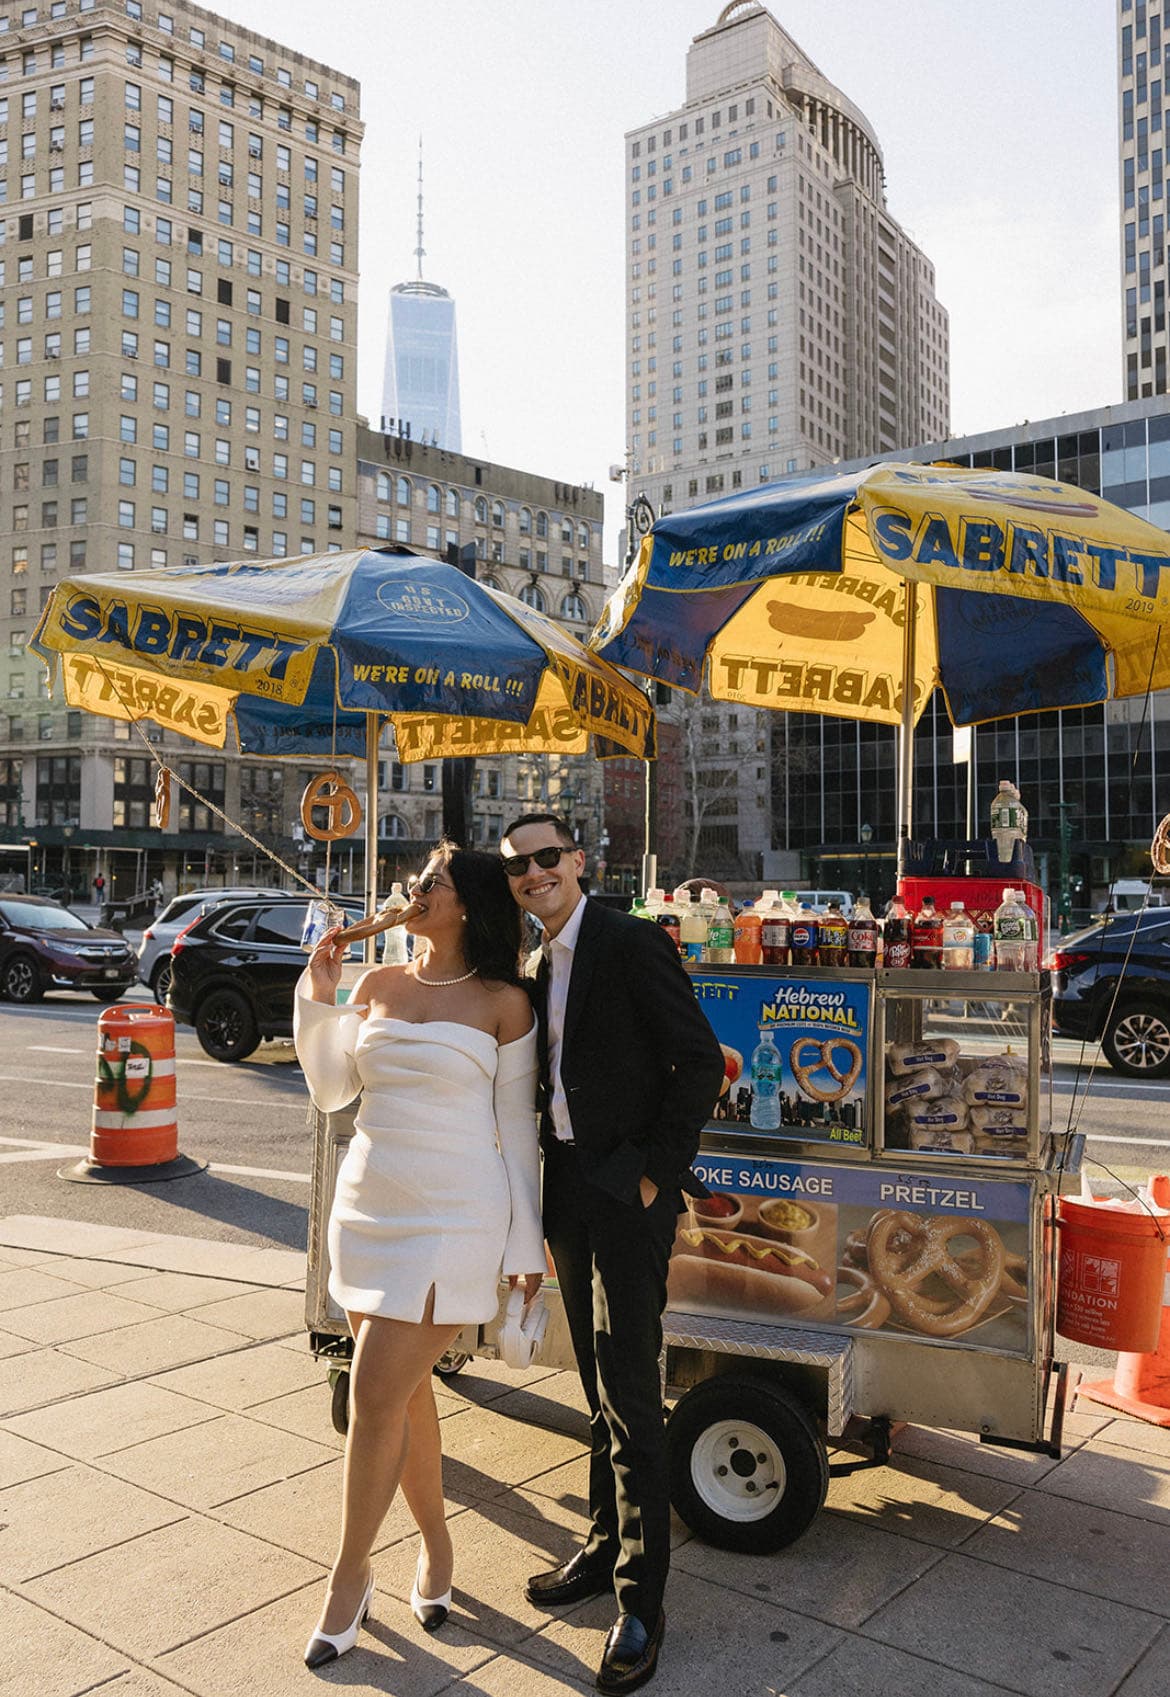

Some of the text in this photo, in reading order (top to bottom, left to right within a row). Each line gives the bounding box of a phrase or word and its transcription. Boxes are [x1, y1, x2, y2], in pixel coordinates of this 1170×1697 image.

[669, 546, 719, 567] WE'RE
[723, 542, 748, 561] ON
[749, 540, 761, 556] A
[871, 505, 1170, 599] SABRETT
[1124, 597, 1155, 614] 2019
[60, 592, 310, 680] SABRETT
[255, 679, 283, 695] 2018
[353, 665, 524, 697] WE'RE ON A ROLL !!!
[775, 986, 844, 1007] Hebrew
[762, 1003, 858, 1028] NATIONAL
[830, 1127, 863, 1142] All Beef
[690, 1165, 833, 1196] OKE SAUSAGE
[880, 1183, 985, 1210] PRETZEL
